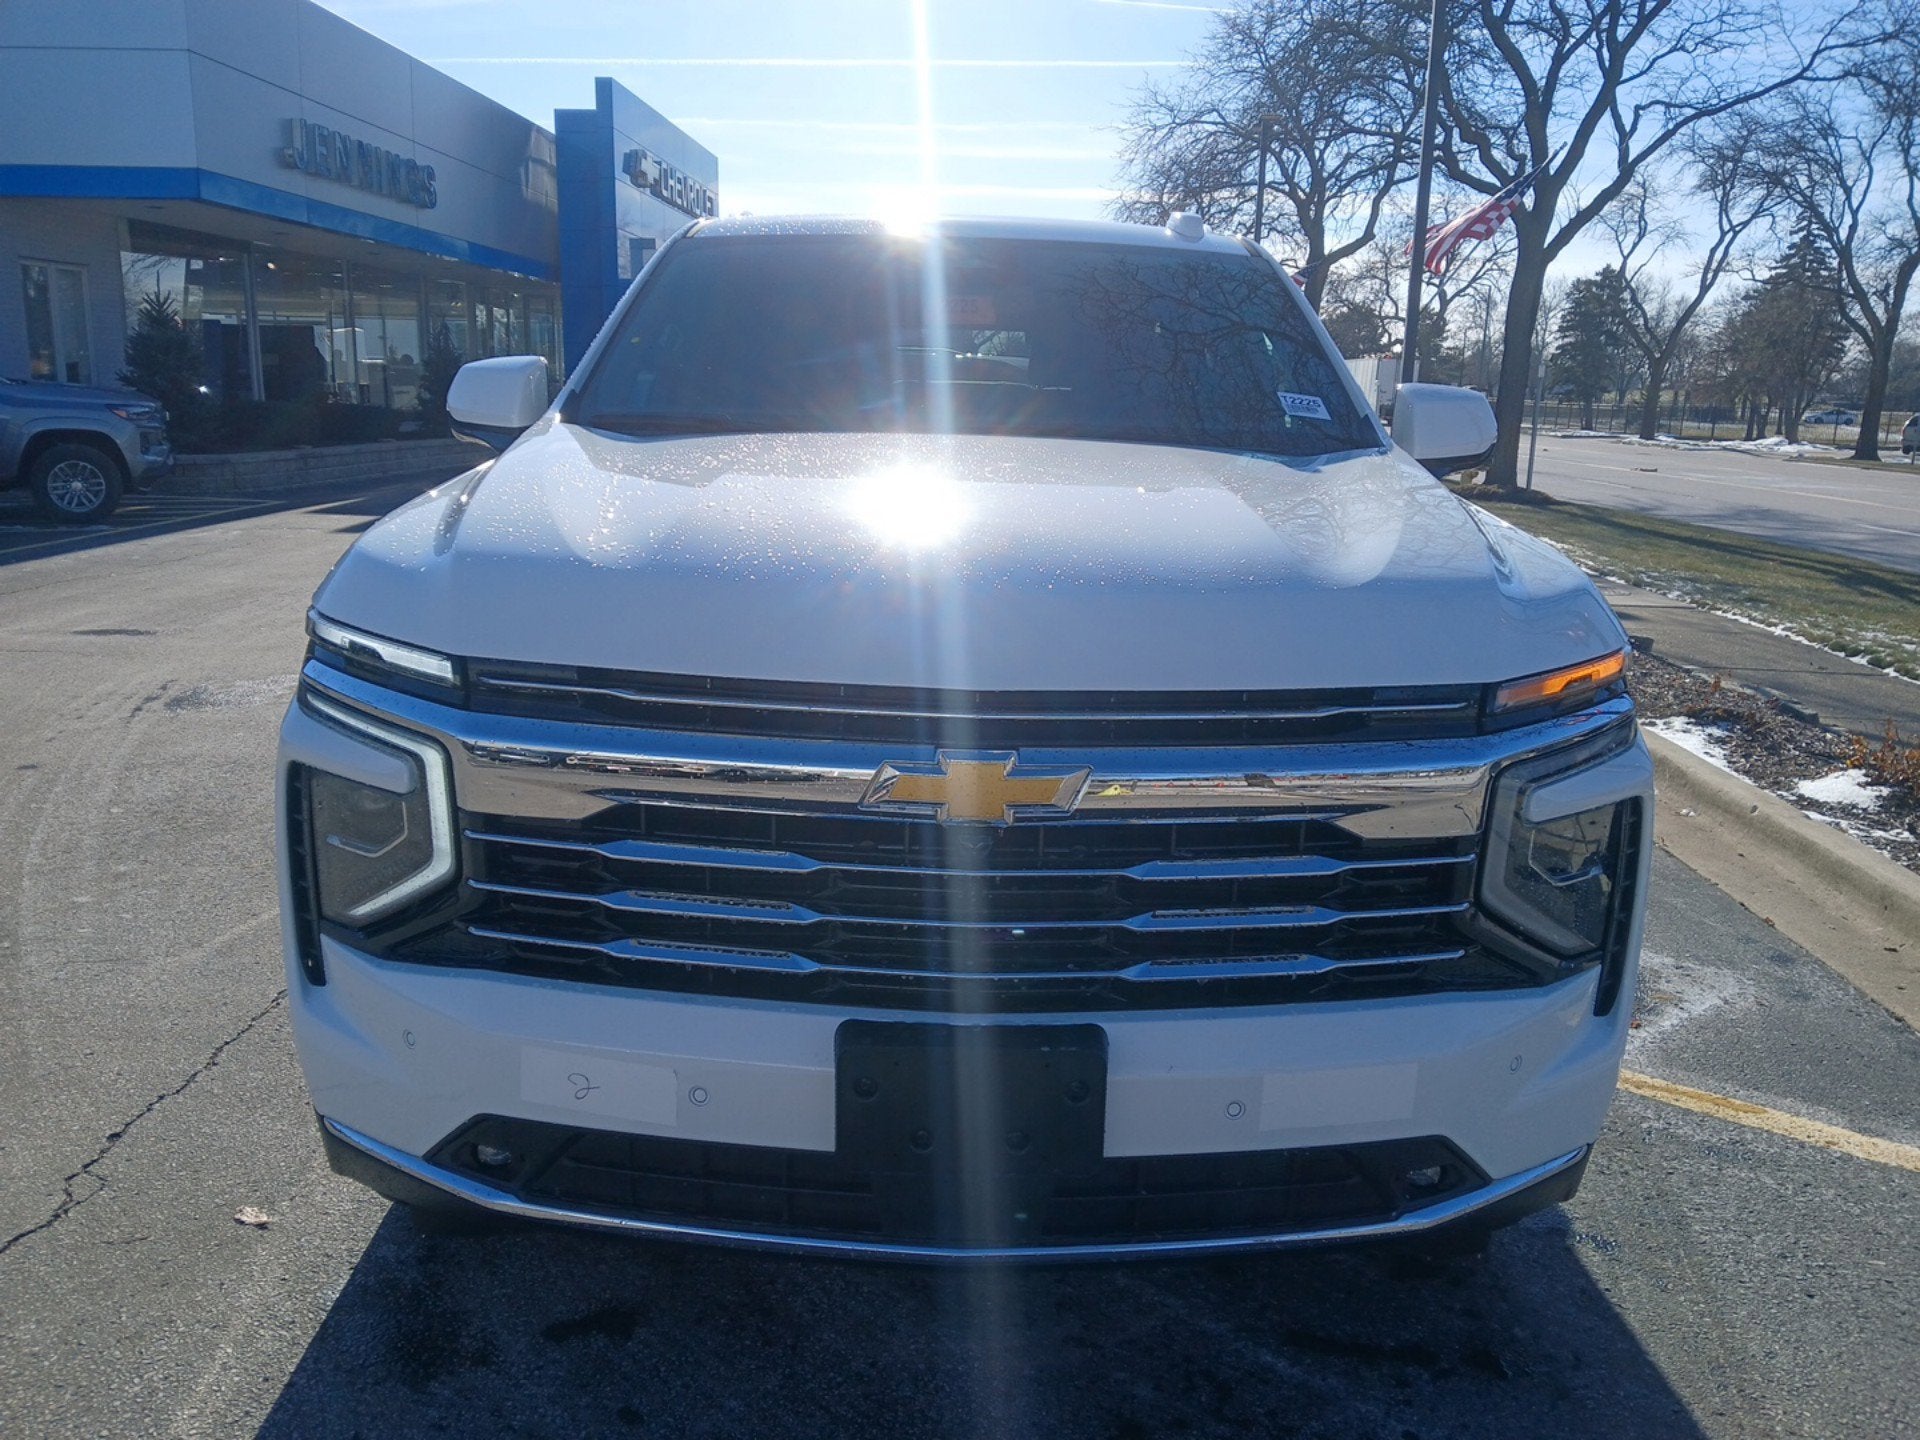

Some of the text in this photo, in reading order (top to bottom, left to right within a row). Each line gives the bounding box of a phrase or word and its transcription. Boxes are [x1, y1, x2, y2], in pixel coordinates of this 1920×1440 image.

[284, 117, 437, 209] JENNINGS
[1280, 395, 1322, 408] T2225
[567, 1072, 600, 1100] 2
